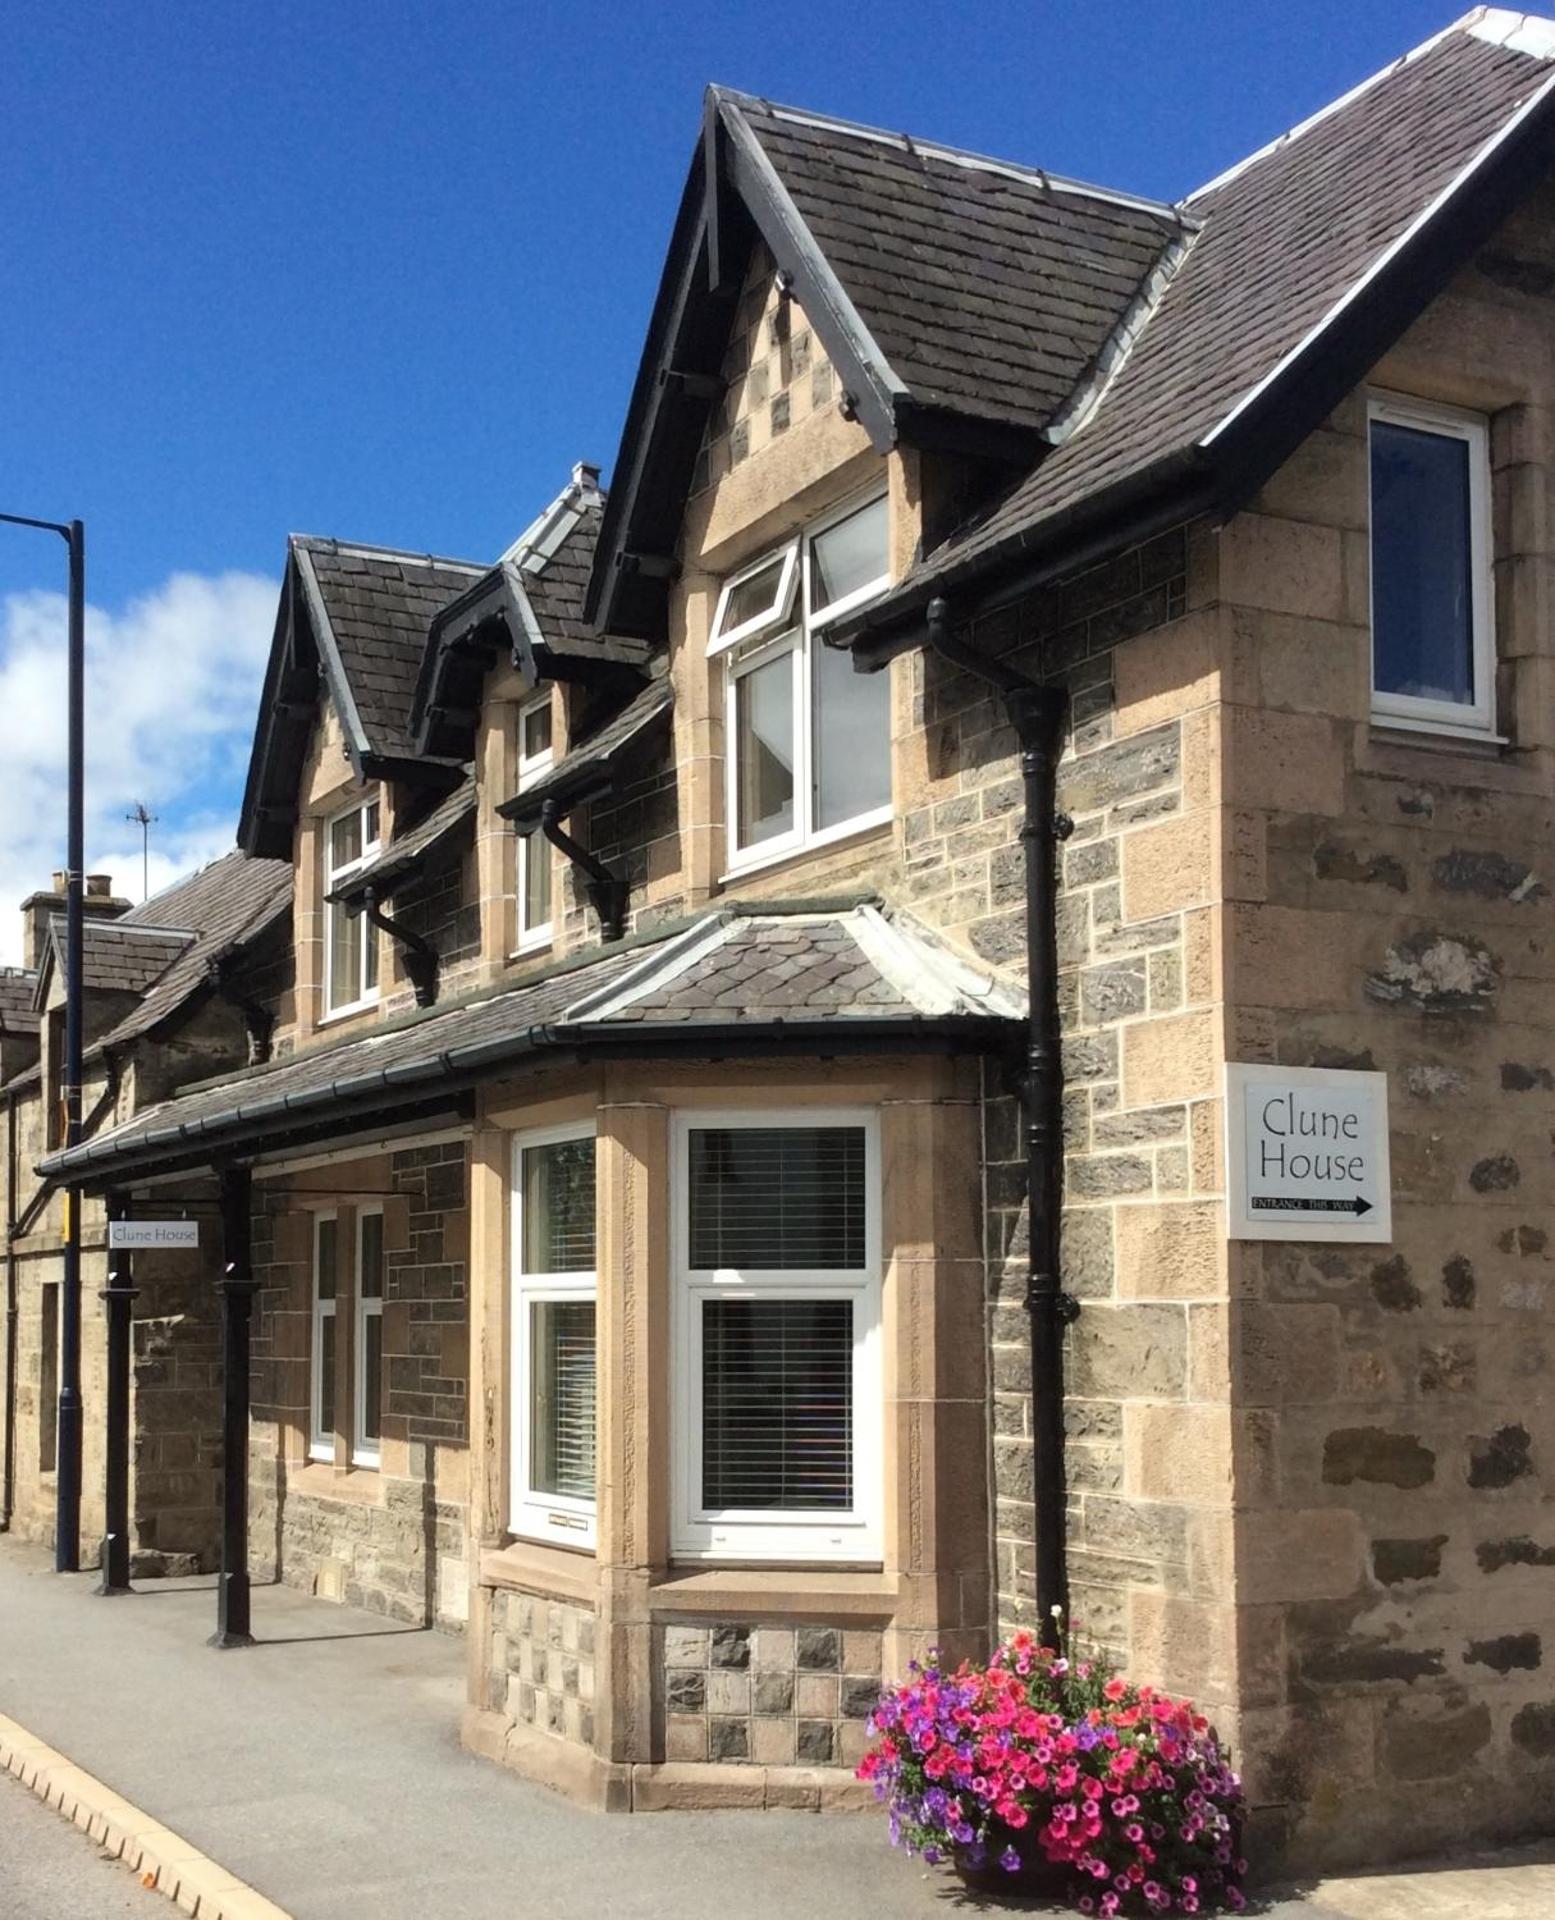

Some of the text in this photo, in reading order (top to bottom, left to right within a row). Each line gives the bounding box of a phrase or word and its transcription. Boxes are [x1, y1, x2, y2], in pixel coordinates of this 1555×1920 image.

[1263, 1092, 1359, 1140] Clune
[1260, 1139, 1364, 1182] House
[1253, 1198, 1355, 1211] ENTRANCE THIS WAY
[113, 1227, 195, 1241] Clune House
